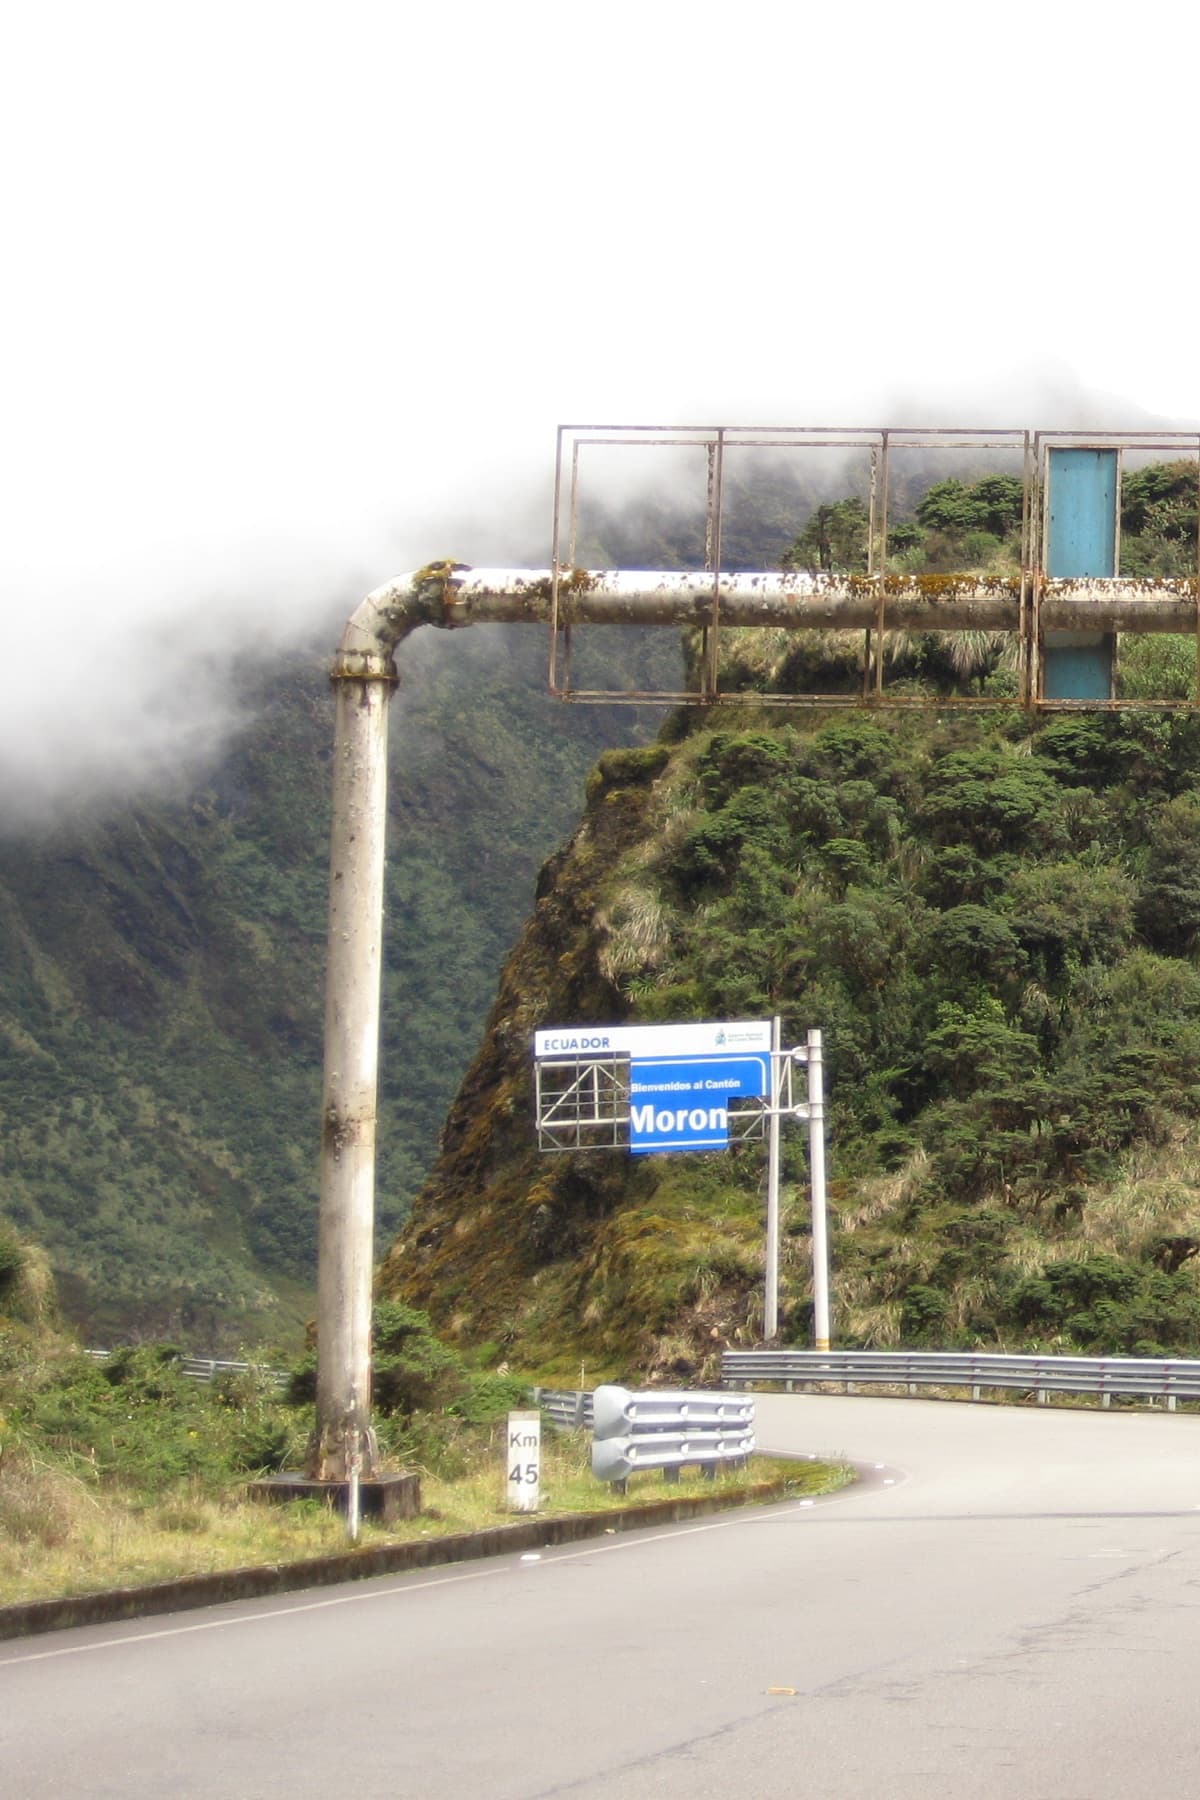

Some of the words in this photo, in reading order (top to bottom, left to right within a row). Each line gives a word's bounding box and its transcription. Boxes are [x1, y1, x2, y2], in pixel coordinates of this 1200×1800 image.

[543, 1037, 610, 1050] ECUADOR
[631, 1082, 691, 1093] Bienvenidos
[693, 1080, 703, 1090] al
[705, 1078, 741, 1089] Cantón
[631, 1105, 728, 1133] Moron
[509, 1432, 537, 1448] Km
[509, 1463, 538, 1484] 45
